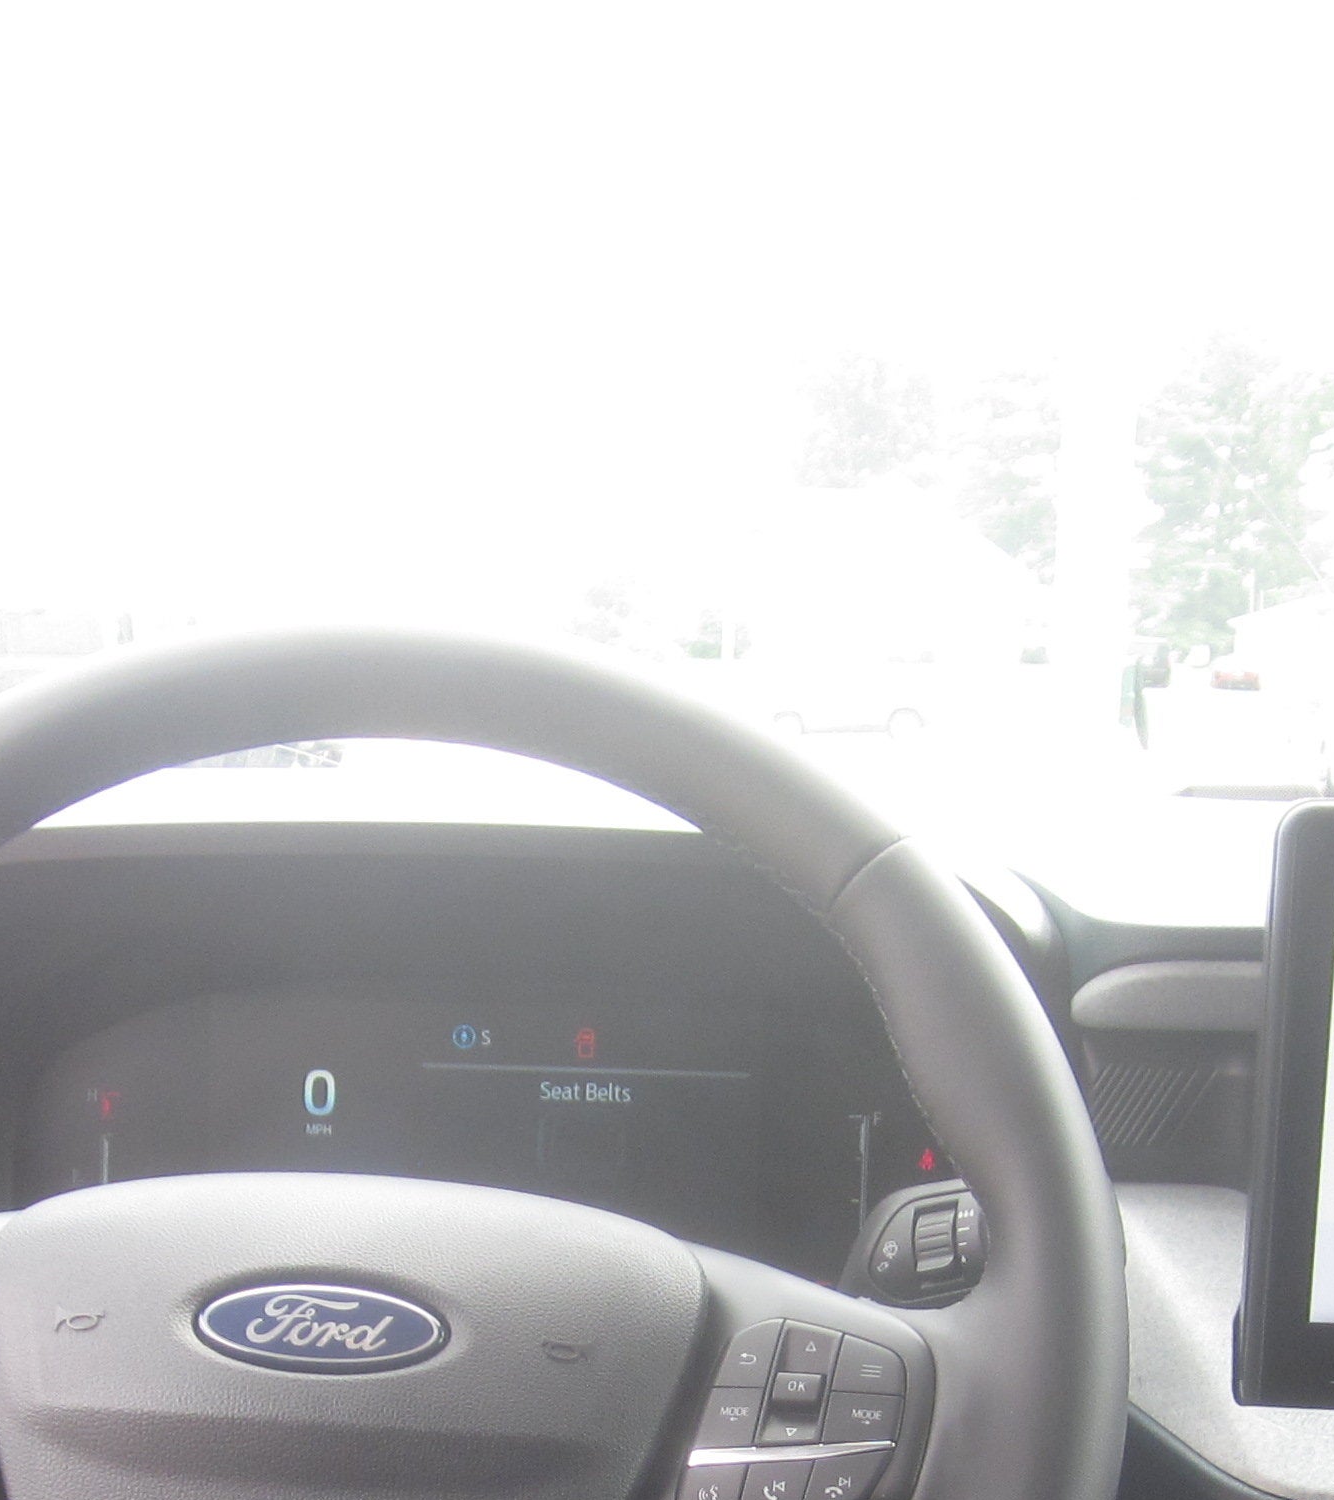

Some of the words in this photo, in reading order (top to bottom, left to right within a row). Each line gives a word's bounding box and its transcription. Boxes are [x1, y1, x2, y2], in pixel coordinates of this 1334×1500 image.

[480, 1029, 492, 1046] S
[304, 1068, 336, 1116] 0
[539, 1080, 580, 1101] Seat
[584, 1081, 632, 1103] Belts
[305, 1122, 332, 1136] MPH
[245, 1293, 394, 1351] Ford
[787, 1380, 806, 1392] OK
[719, 1406, 749, 1417] MODE
[851, 1408, 883, 1421] MODE
